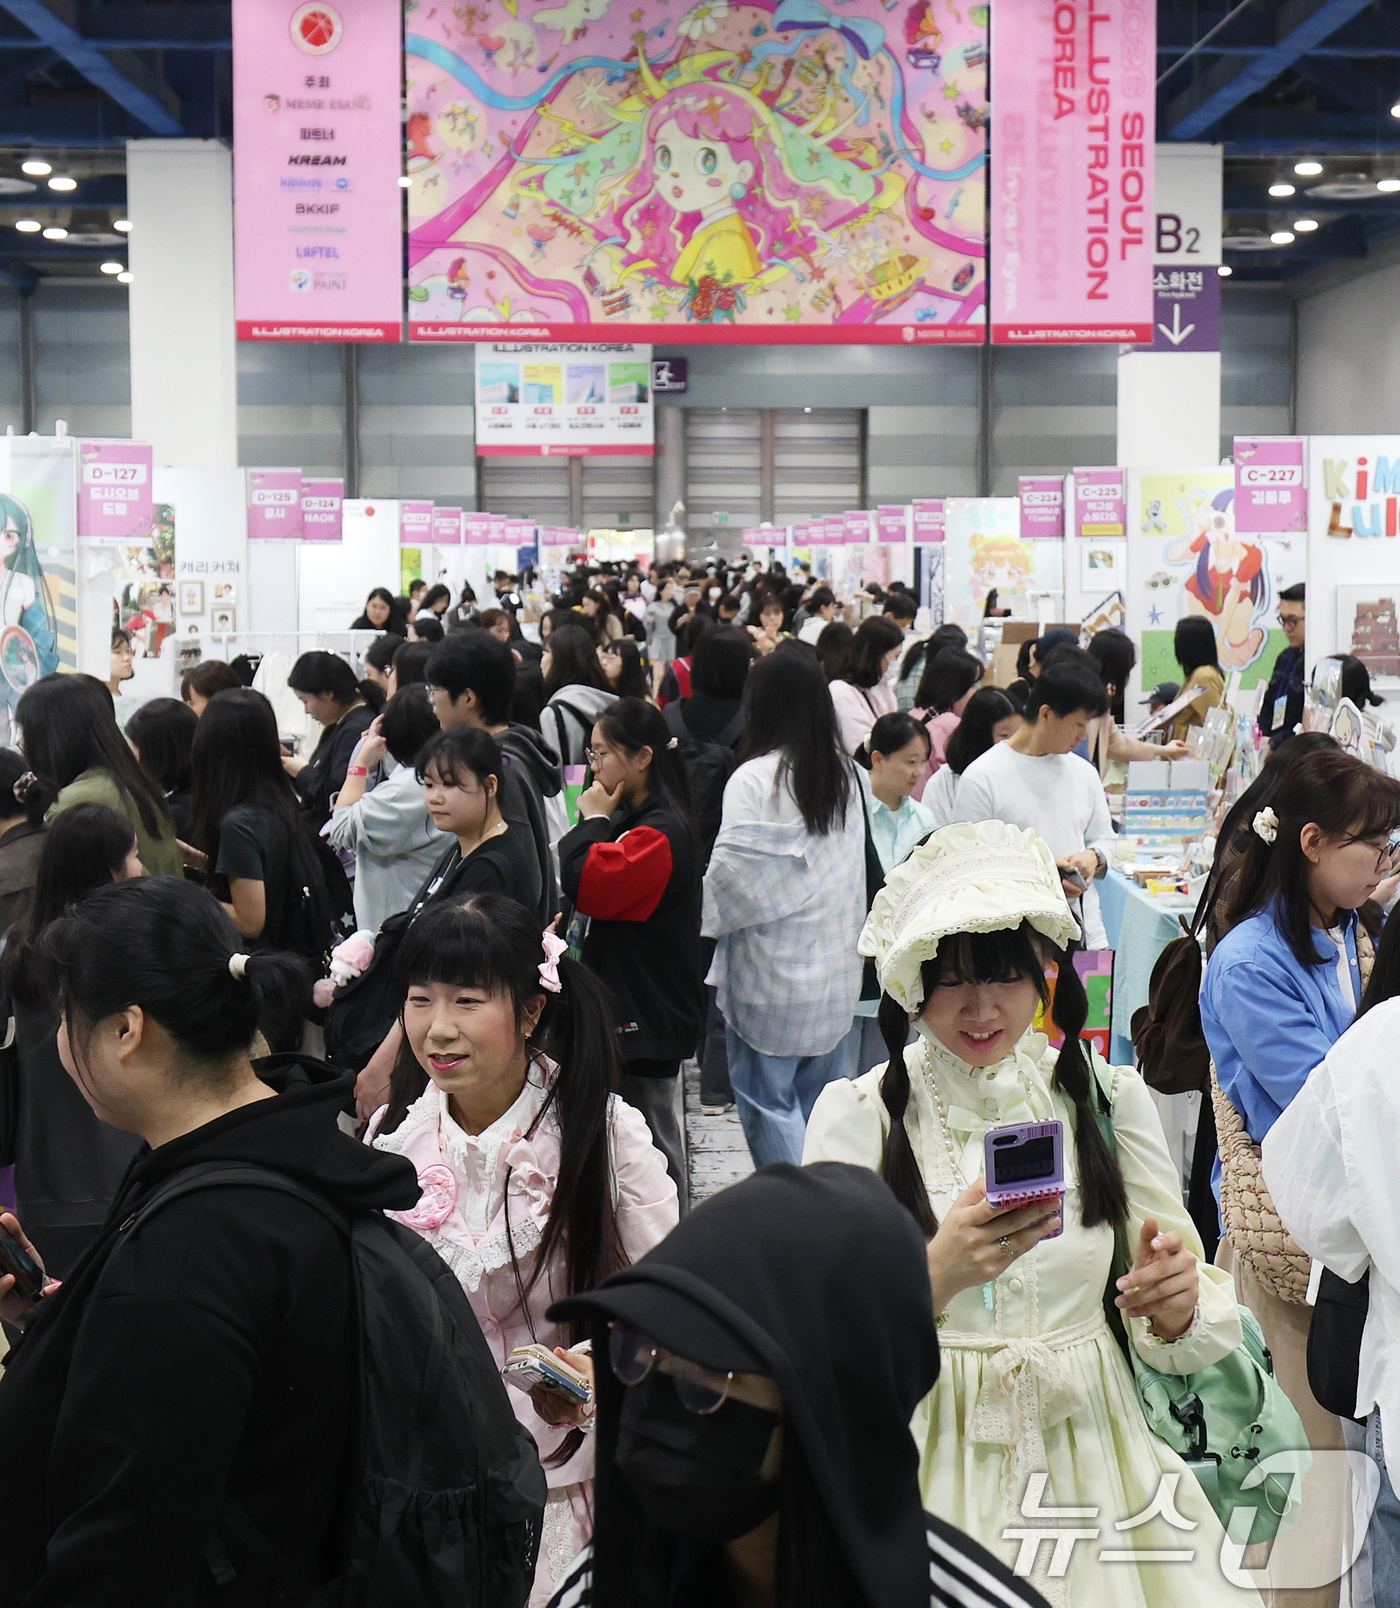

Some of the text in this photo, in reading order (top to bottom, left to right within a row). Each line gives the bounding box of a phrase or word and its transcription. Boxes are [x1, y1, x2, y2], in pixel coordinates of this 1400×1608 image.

[1053, 0, 1076, 120] OREA
[299, 128, 335, 141] 파트너
[1120, 0, 1146, 261] 026 SEOUL
[288, 155, 347, 166] KREAM
[295, 203, 339, 215] BKKIF
[296, 246, 339, 259] LAFTEL
[1153, 270, 1203, 292] 소화전
[251, 326, 384, 338] ILLUSTRATION KOREA
[417, 326, 551, 336] ILLUSTRATION KOREA
[1007, 329, 1137, 339] ILLUSTRATION KOREA
[492, 343, 635, 352] ILLUSTRATION KOREA
[92, 467, 137, 480] D-127
[1247, 469, 1295, 481] C-227
[257, 492, 291, 502] D-125
[1082, 487, 1118, 496] C-225
[305, 500, 334, 508] D-124
[1026, 494, 1057, 502] C-224
